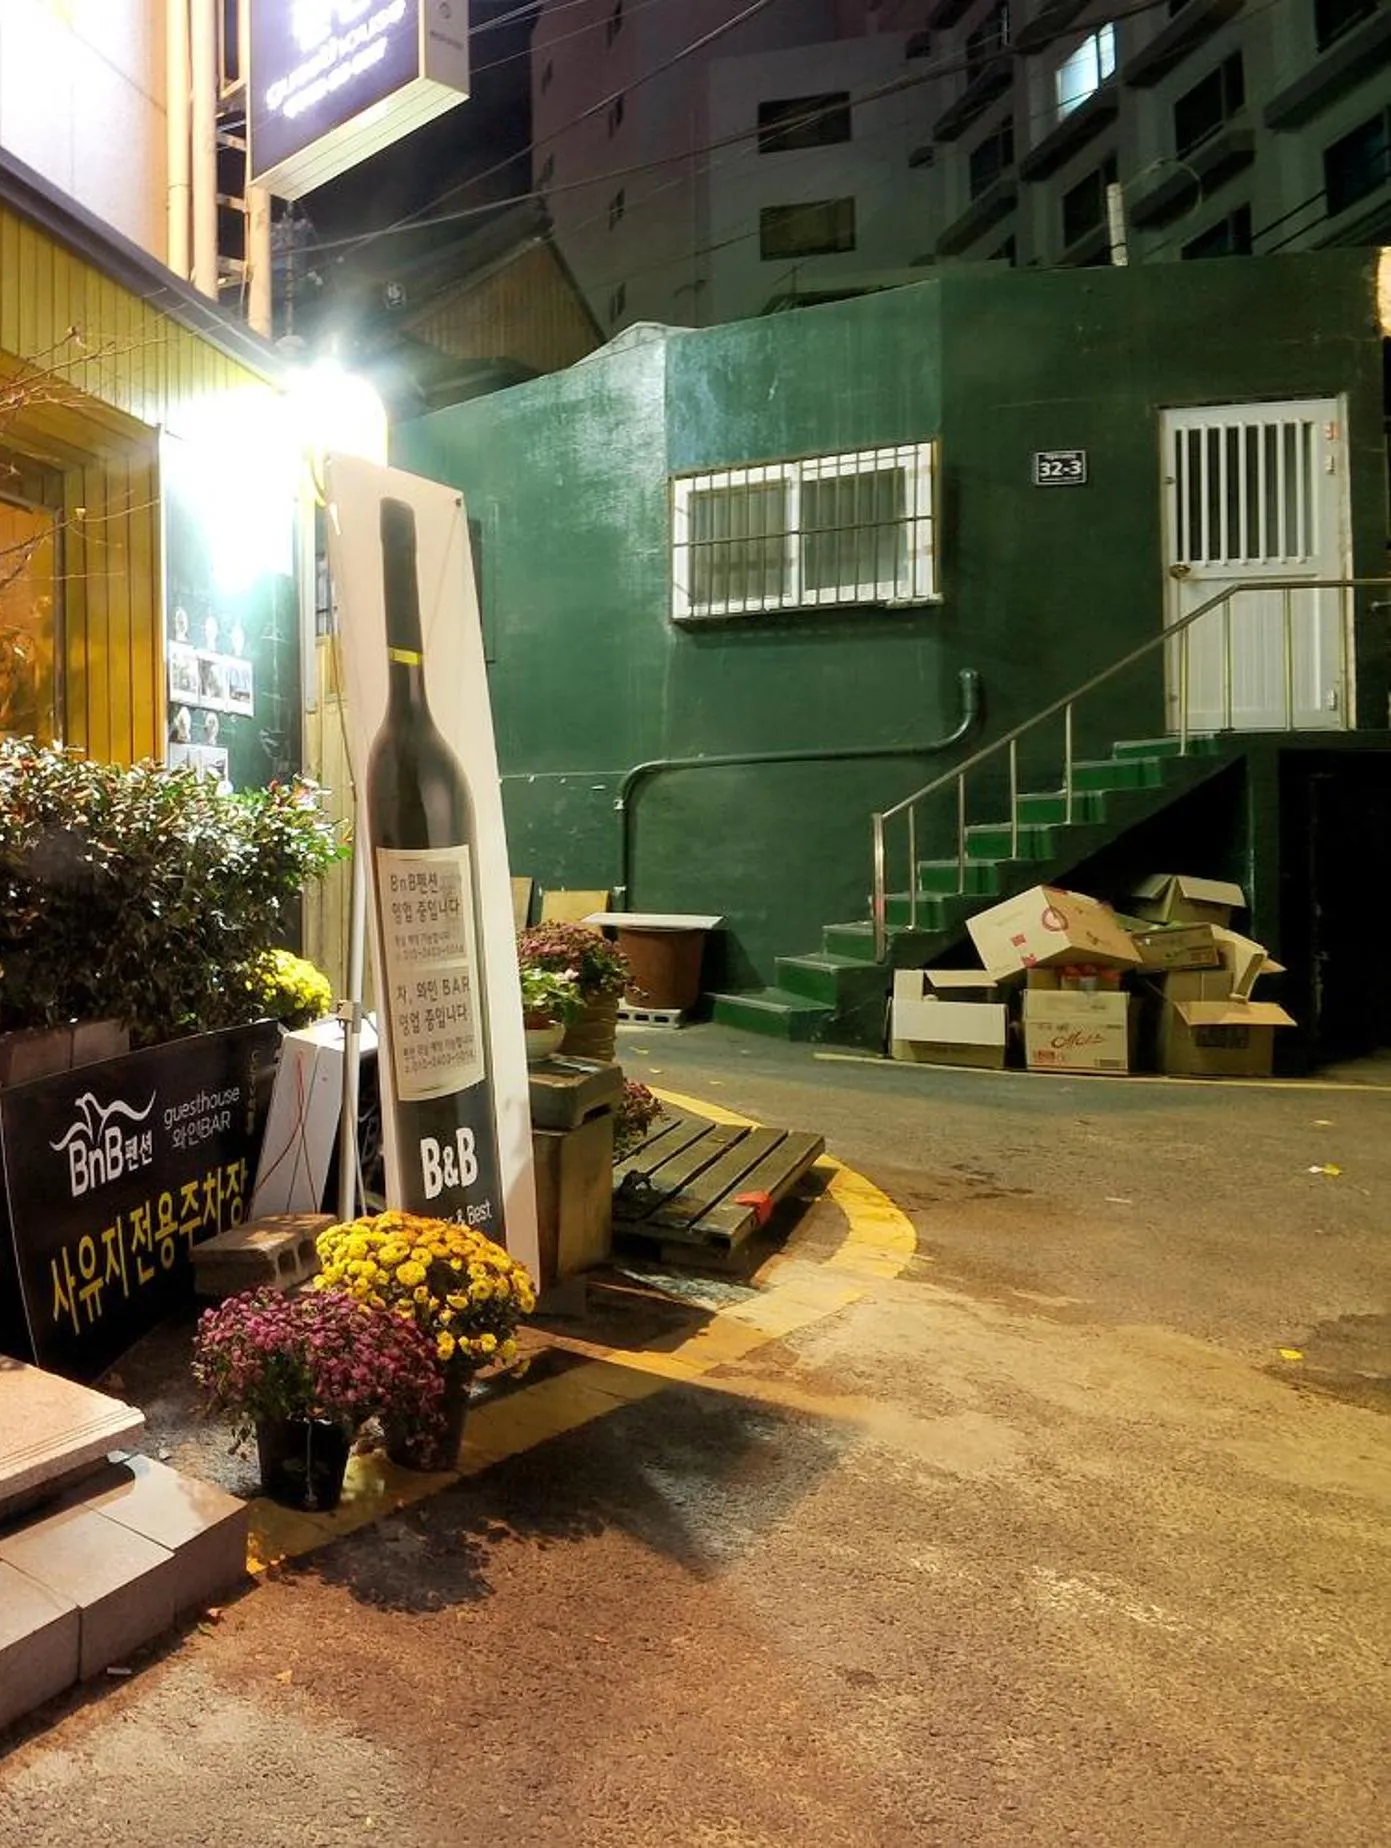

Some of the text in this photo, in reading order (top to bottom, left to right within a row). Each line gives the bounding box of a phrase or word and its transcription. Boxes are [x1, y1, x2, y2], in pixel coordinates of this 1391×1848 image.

[1039, 460, 1082, 477] 32-3
[416, 897, 461, 923] 중입니다
[442, 975, 470, 996] BAR
[425, 1003, 468, 1033] 중입니다
[163, 1086, 241, 1131] guesthouse
[172, 1110, 232, 1149] 와인BAR
[420, 1127, 479, 1200] B&B
[466, 1199, 493, 1226] Best
